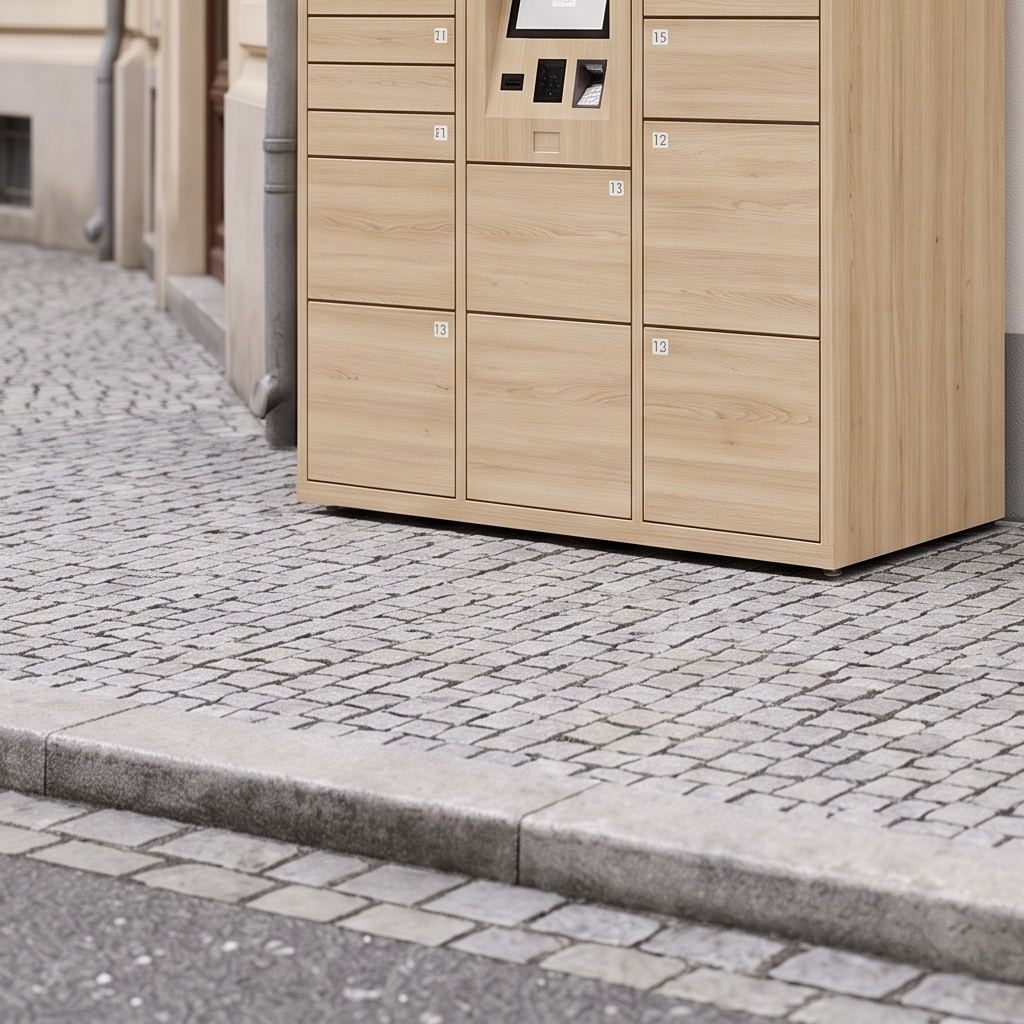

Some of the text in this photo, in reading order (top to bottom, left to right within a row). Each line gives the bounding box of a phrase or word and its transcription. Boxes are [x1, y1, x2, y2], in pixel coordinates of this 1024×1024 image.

[654, 31, 667, 44] 15
[653, 134, 667, 146] 12
[610, 182, 623, 194] 13
[435, 324, 447, 336] 13
